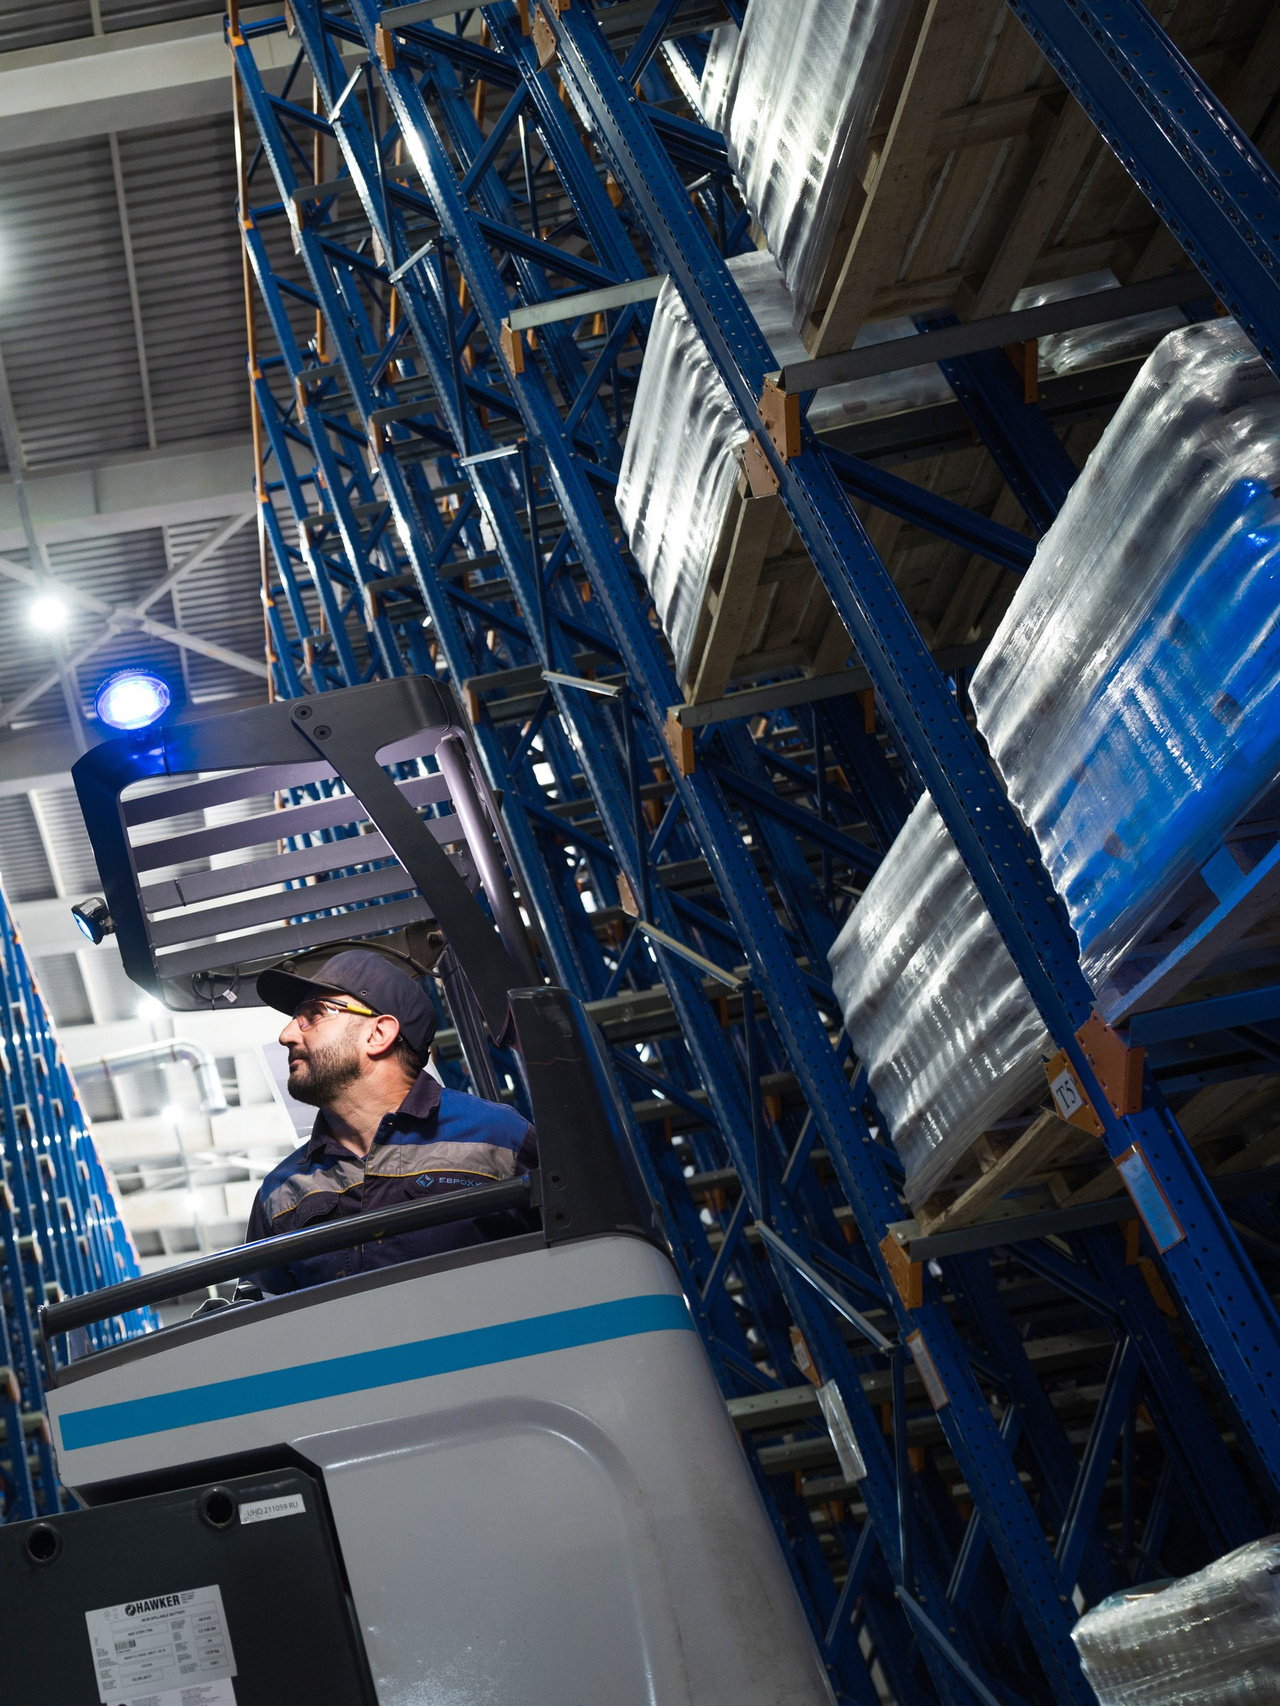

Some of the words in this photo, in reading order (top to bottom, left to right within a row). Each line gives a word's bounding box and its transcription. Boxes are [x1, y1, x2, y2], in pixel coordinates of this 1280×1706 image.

[1056, 1080, 1076, 1109] T5
[438, 1177, 483, 1187] ЕВРОХИ
[246, 1507, 263, 1517] UHD
[264, 1503, 288, 1514] 211059
[288, 1501, 299, 1510] RU
[135, 1594, 181, 1614] HAWKER
